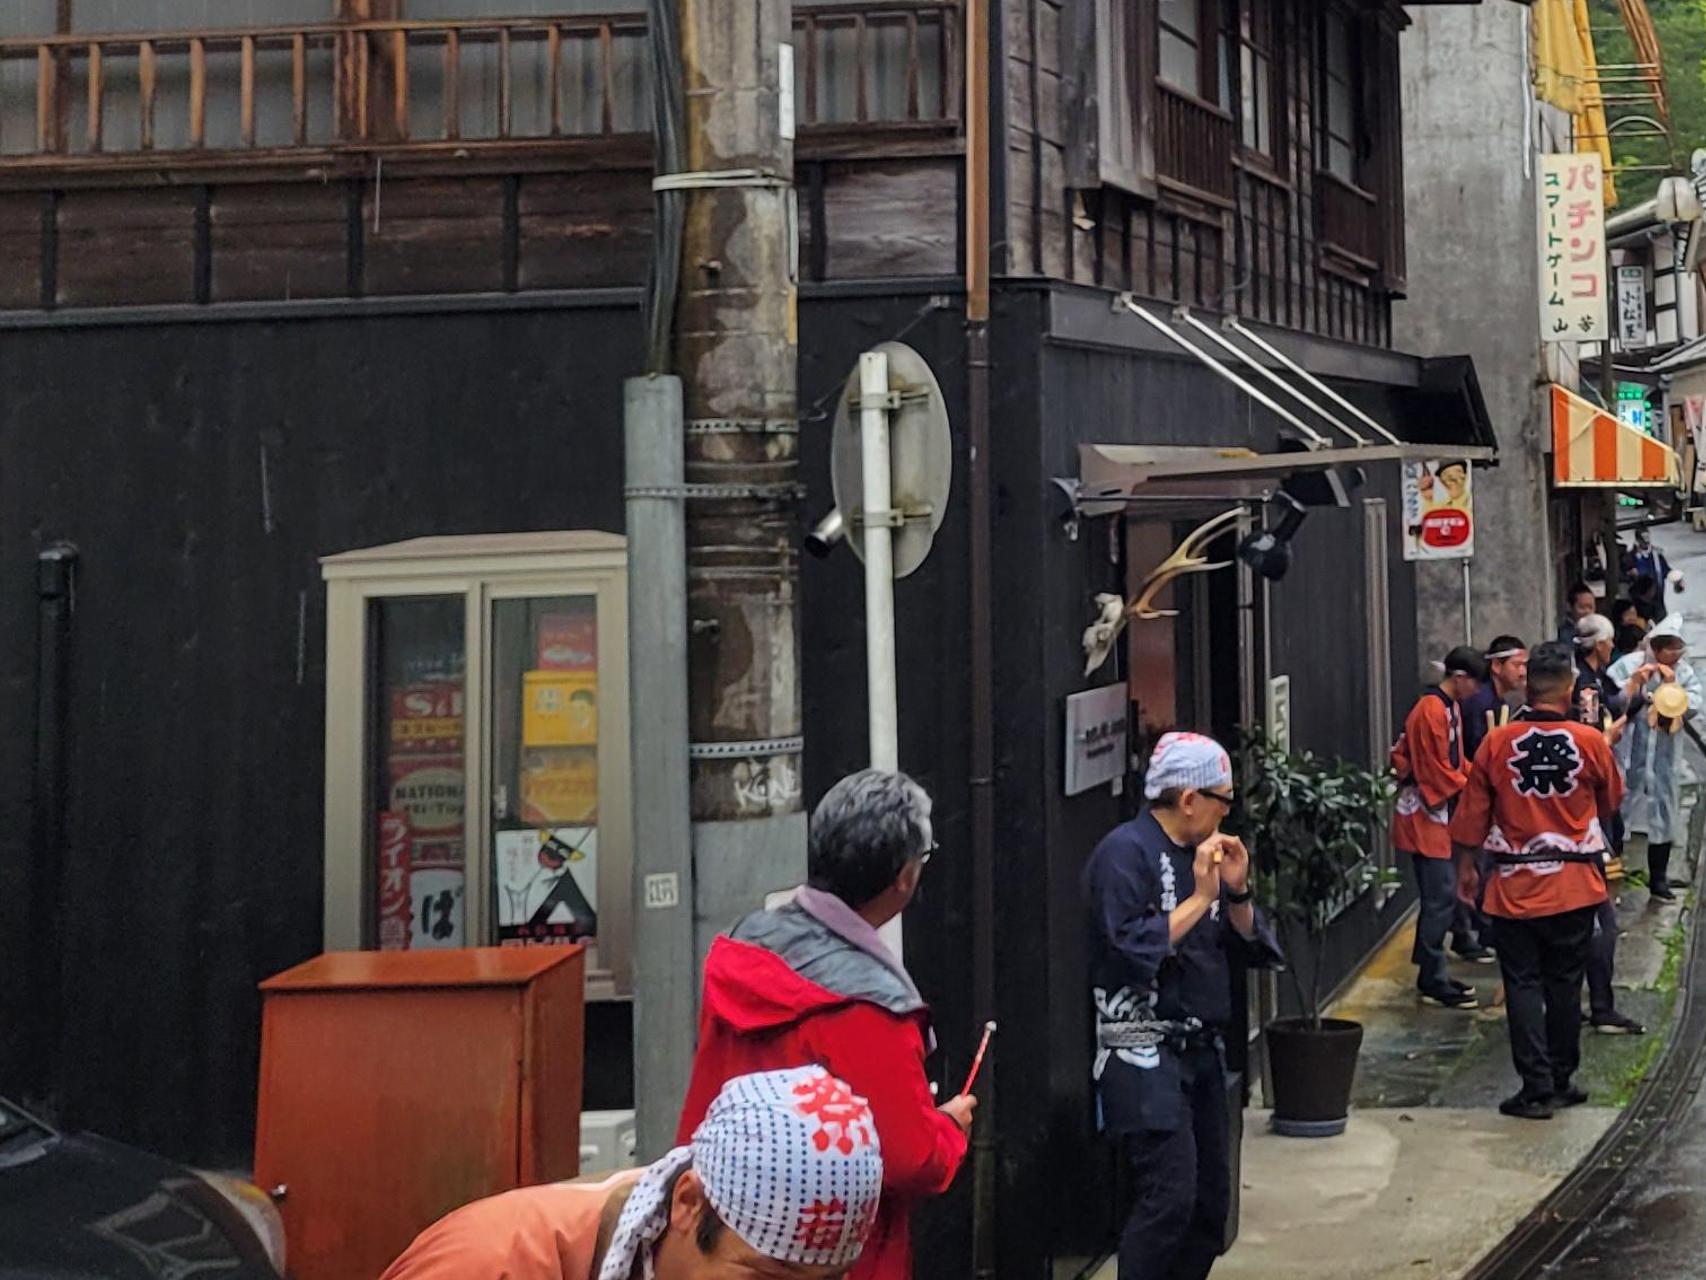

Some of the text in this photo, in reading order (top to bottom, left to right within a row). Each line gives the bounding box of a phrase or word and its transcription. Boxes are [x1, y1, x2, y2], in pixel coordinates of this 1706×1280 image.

[1566, 165, 1597, 298] パチンコ
[1509, 728, 1584, 797] 祭
